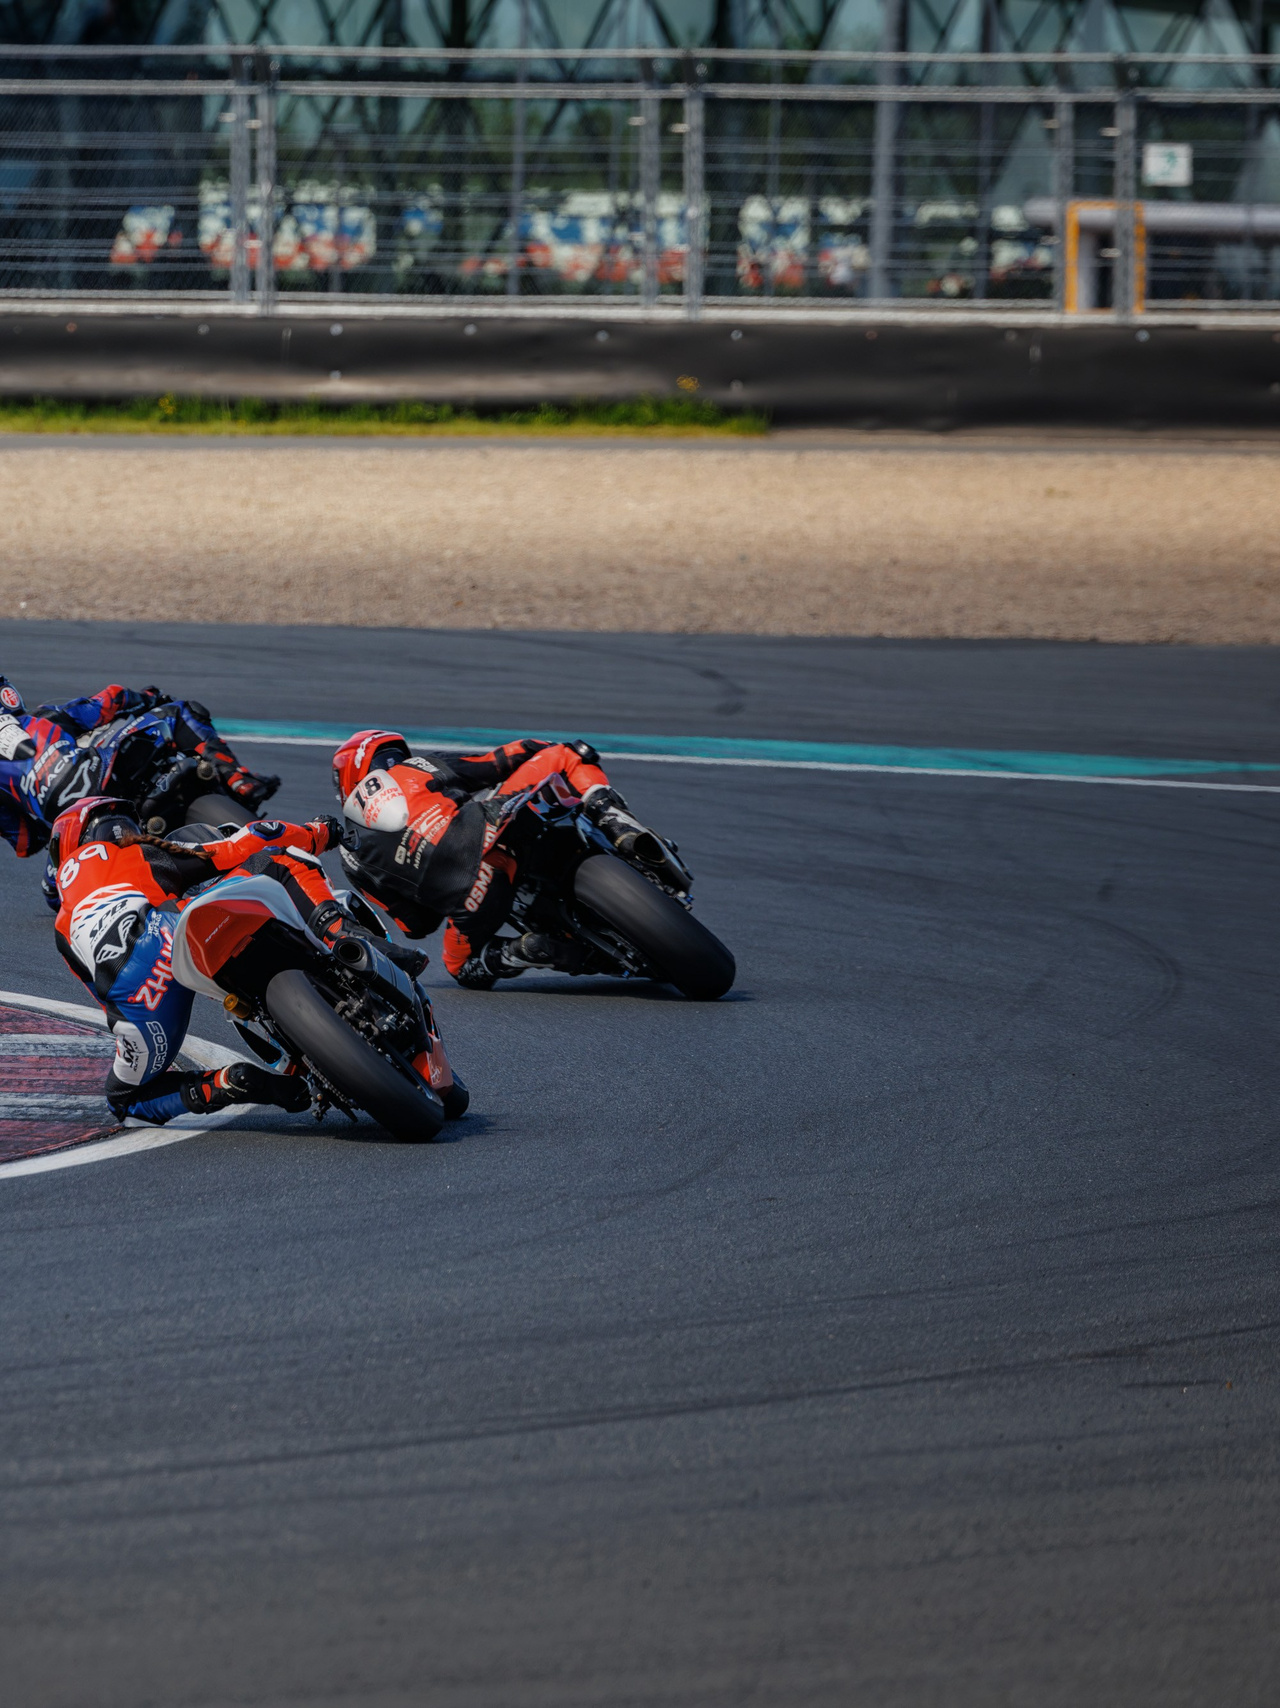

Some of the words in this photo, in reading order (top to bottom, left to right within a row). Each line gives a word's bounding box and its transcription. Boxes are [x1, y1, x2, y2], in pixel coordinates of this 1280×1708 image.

[33, 740, 70, 774] SPEED
[36, 749, 60, 781] PRO
[353, 776, 382, 812] 18
[60, 843, 109, 890] 89
[89, 898, 129, 939] SPB
[145, 1020, 168, 1075] VIRCOS
